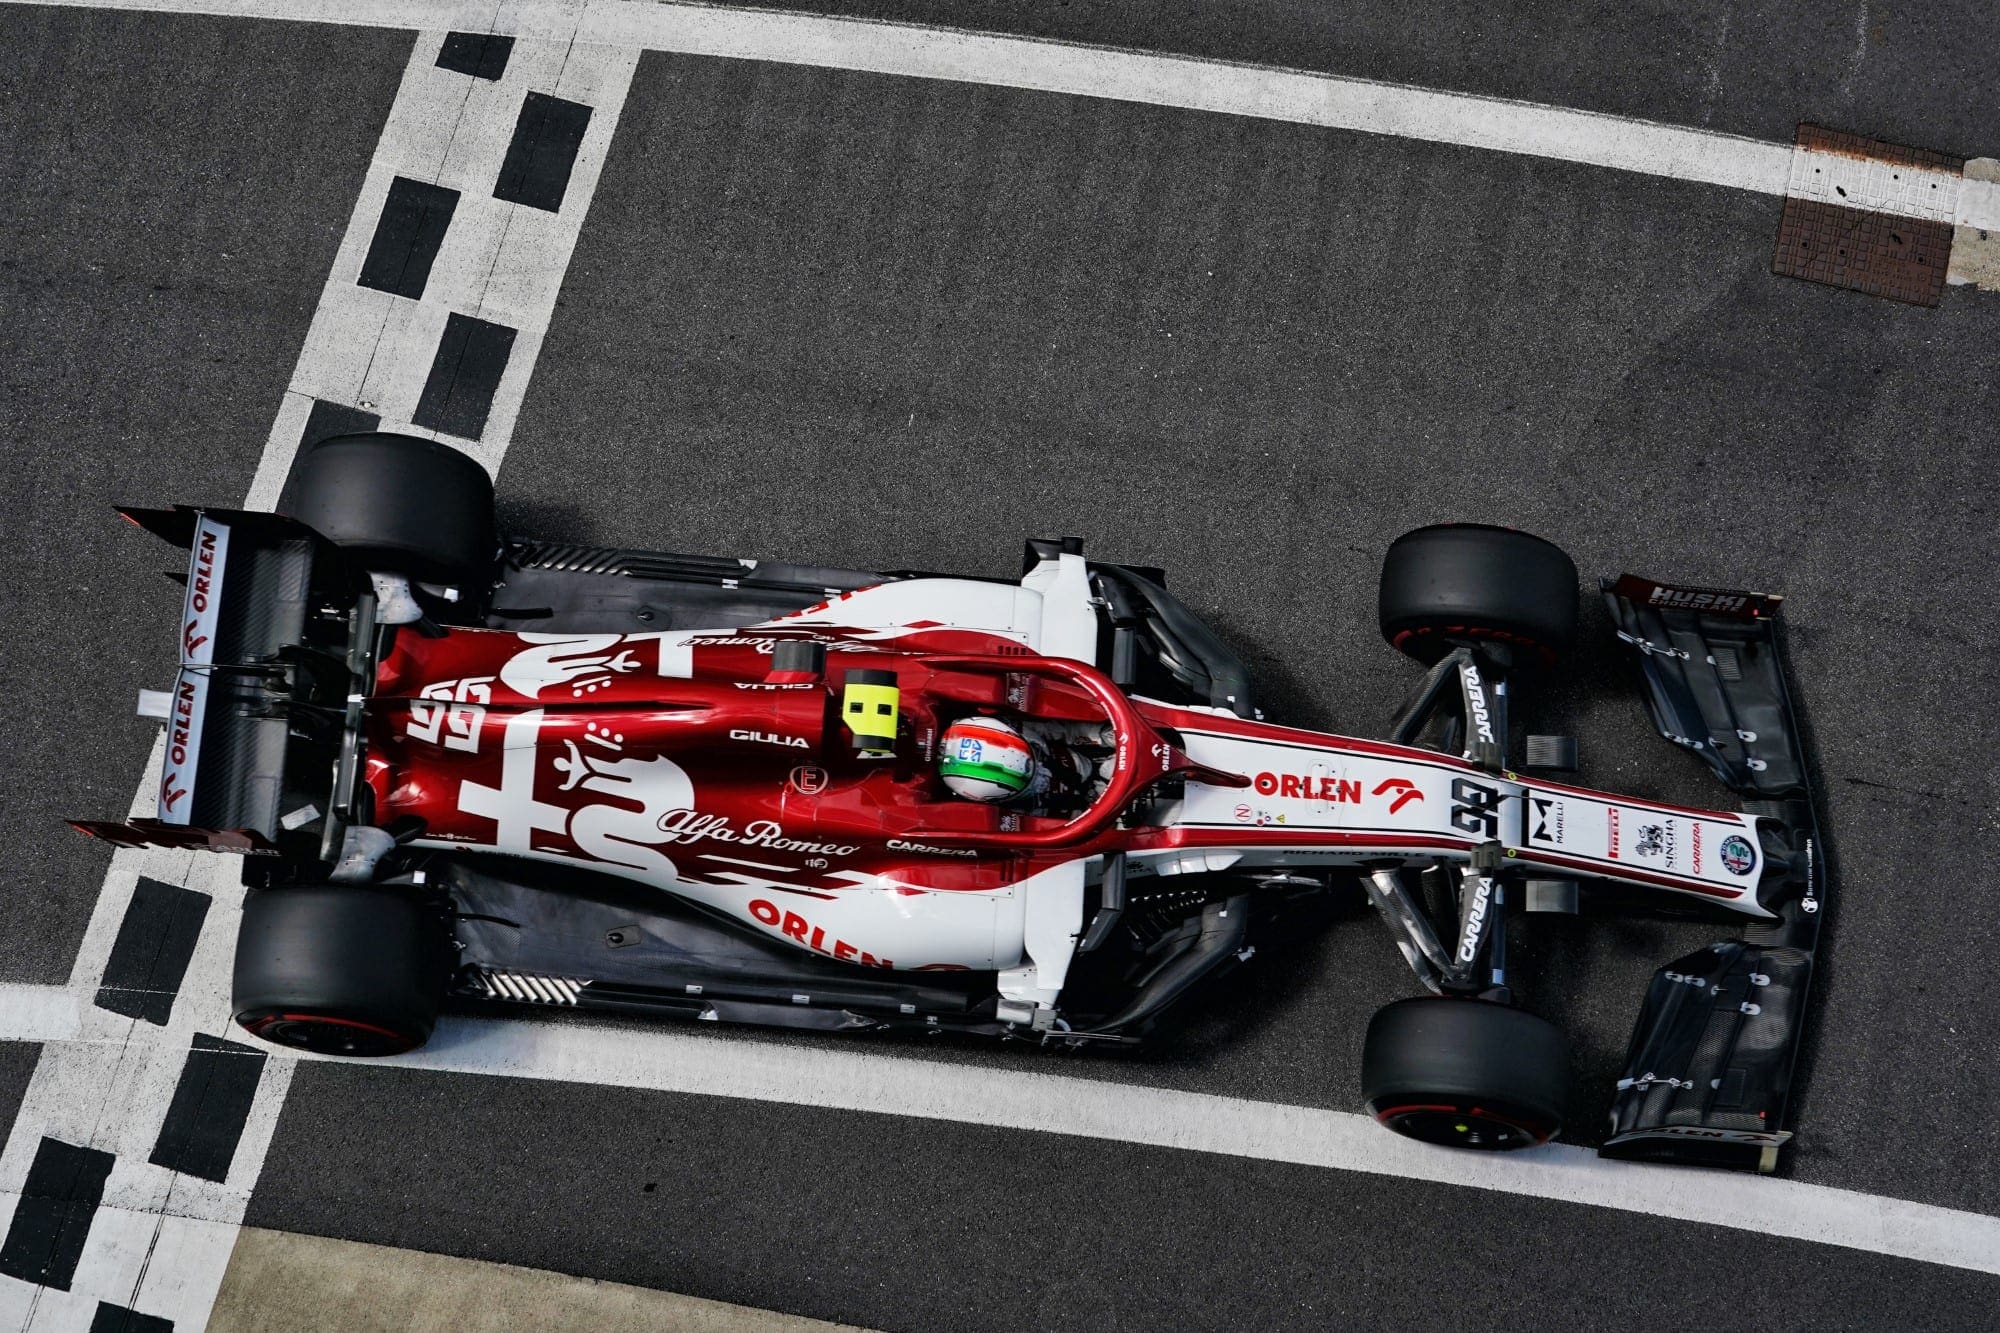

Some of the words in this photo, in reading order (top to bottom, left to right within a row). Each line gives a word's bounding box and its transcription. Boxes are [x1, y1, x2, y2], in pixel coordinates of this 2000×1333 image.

[193, 530, 217, 613] ORLEN
[1648, 598, 1741, 612] CHOCOLATE
[1651, 586, 1748, 607] HUSKI
[733, 682, 814, 691] GIULIA
[170, 681, 196, 766] ORLEN
[729, 729, 810, 749] GIULIA
[1118, 746, 1127, 771] ORLEN
[1161, 743, 1171, 772] ORLEN
[1254, 771, 1362, 804] ORLEN
[657, 808, 740, 844] Alfa
[738, 820, 860, 856] Romeo
[1556, 801, 1564, 844] MARELLI
[886, 839, 978, 857] CARRERA
[1665, 819, 1674, 868] SINGHA
[1693, 822, 1701, 875] CARRERA
[1460, 877, 1493, 962] CARRERA
